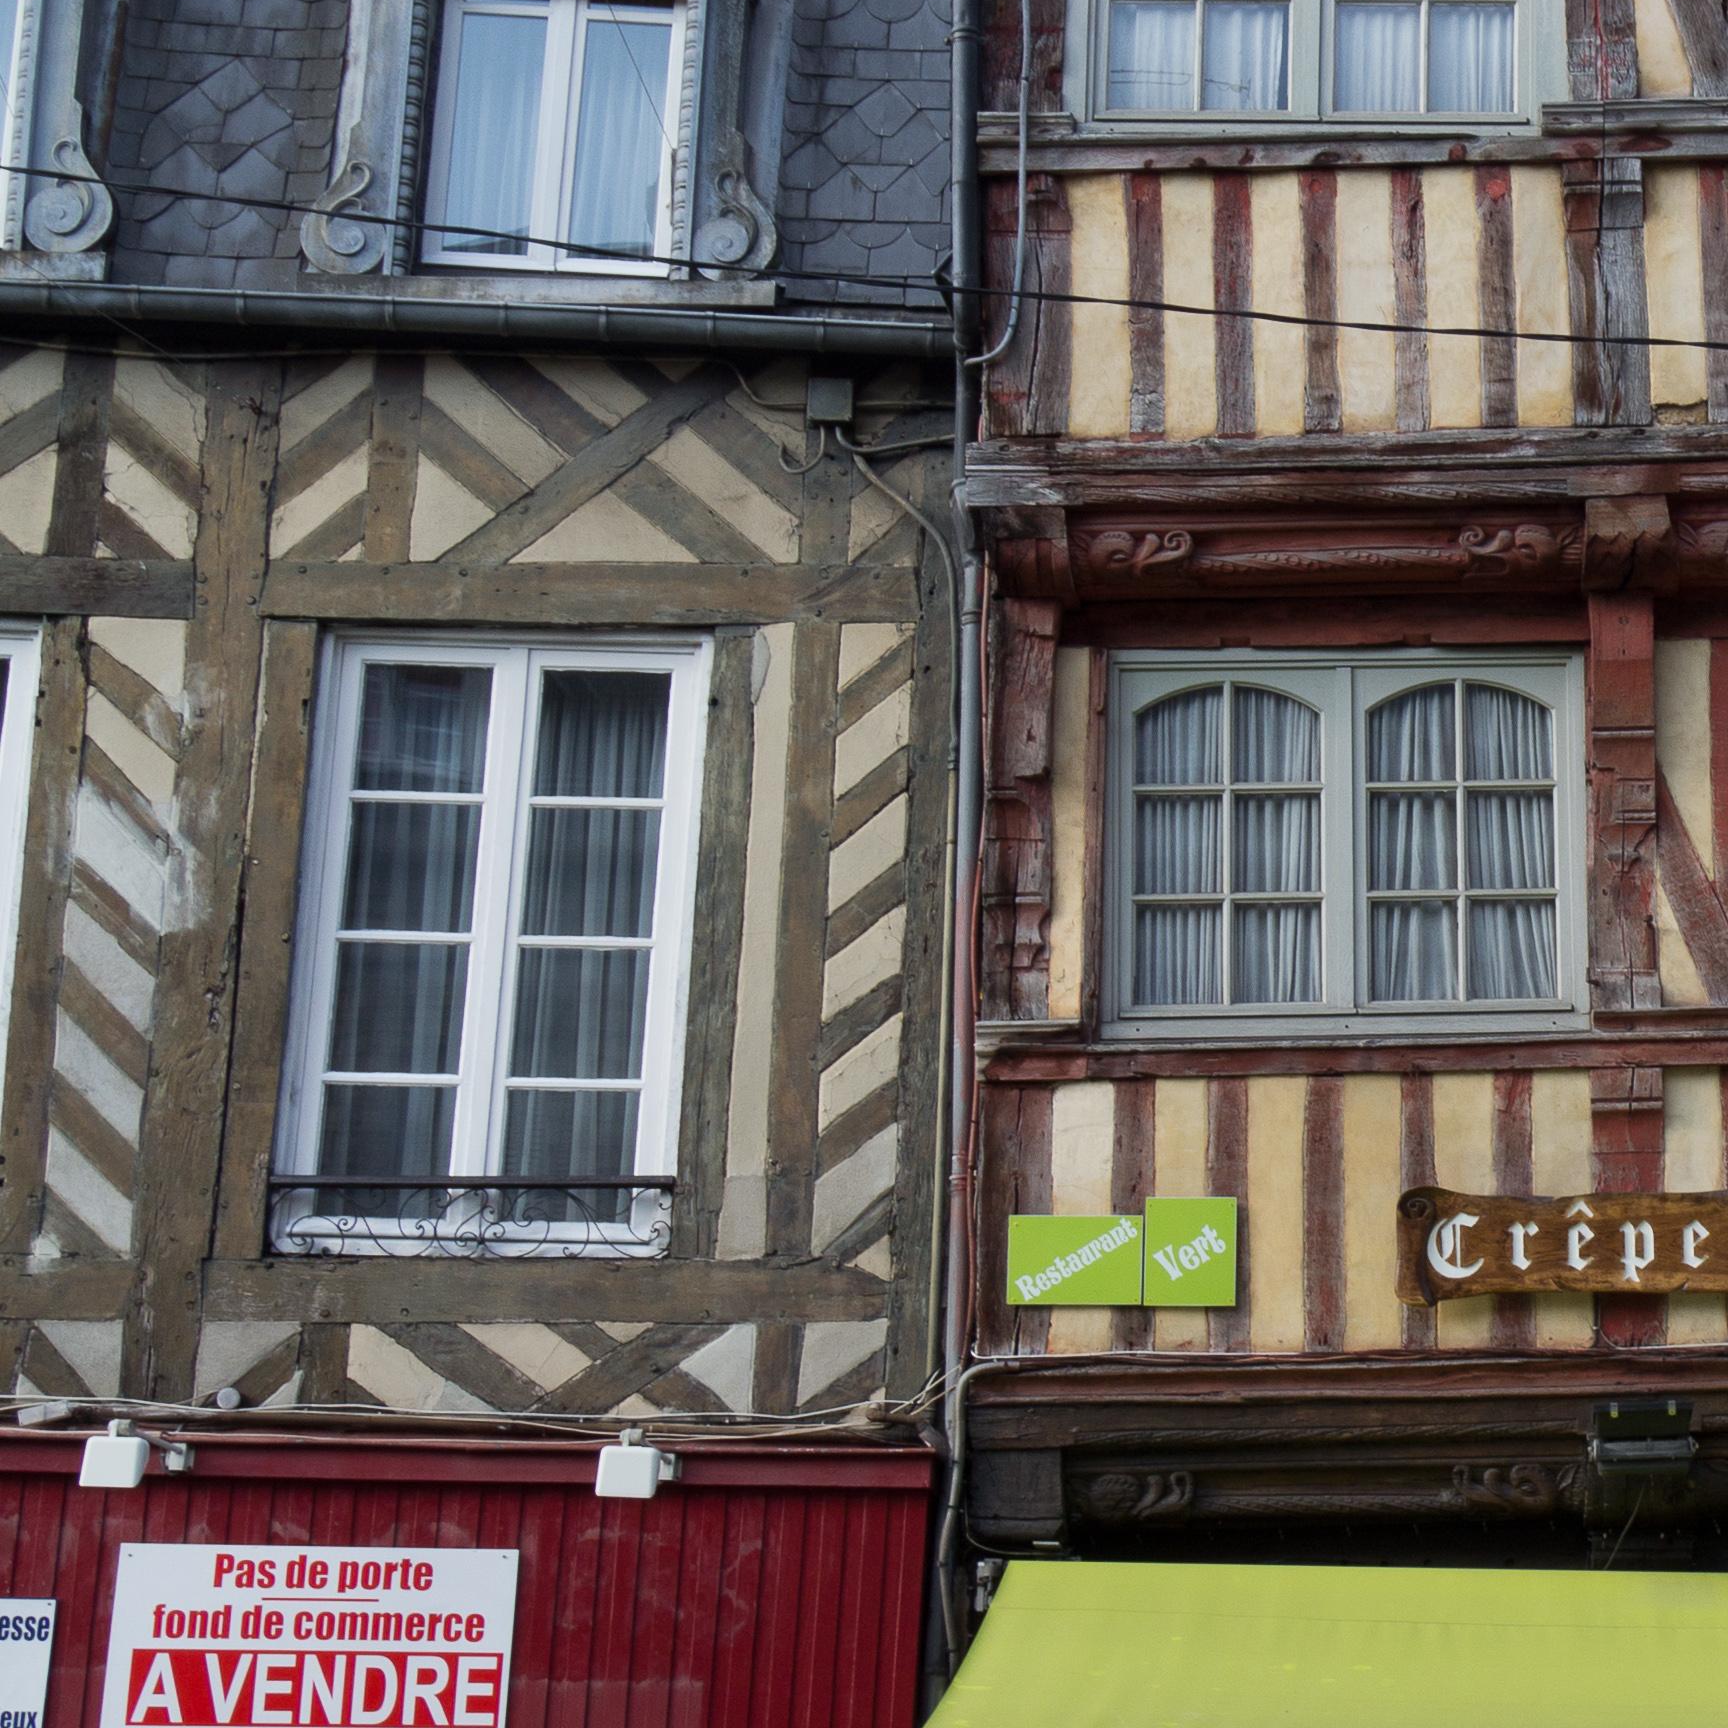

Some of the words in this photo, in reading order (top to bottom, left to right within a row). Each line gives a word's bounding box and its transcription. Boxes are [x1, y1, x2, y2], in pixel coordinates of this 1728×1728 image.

[1014, 1217, 1138, 1302] Restaurant
[1153, 1224, 1227, 1281] Vert
[213, 1553, 276, 1589] Pas
[285, 1553, 328, 1590] de
[337, 1557, 434, 1593] porte
[152, 1603, 231, 1640] fond
[240, 1604, 284, 1641] de
[292, 1611, 485, 1643] commerce
[131, 1653, 183, 1725] A
[207, 1653, 496, 1725] VENDRE
